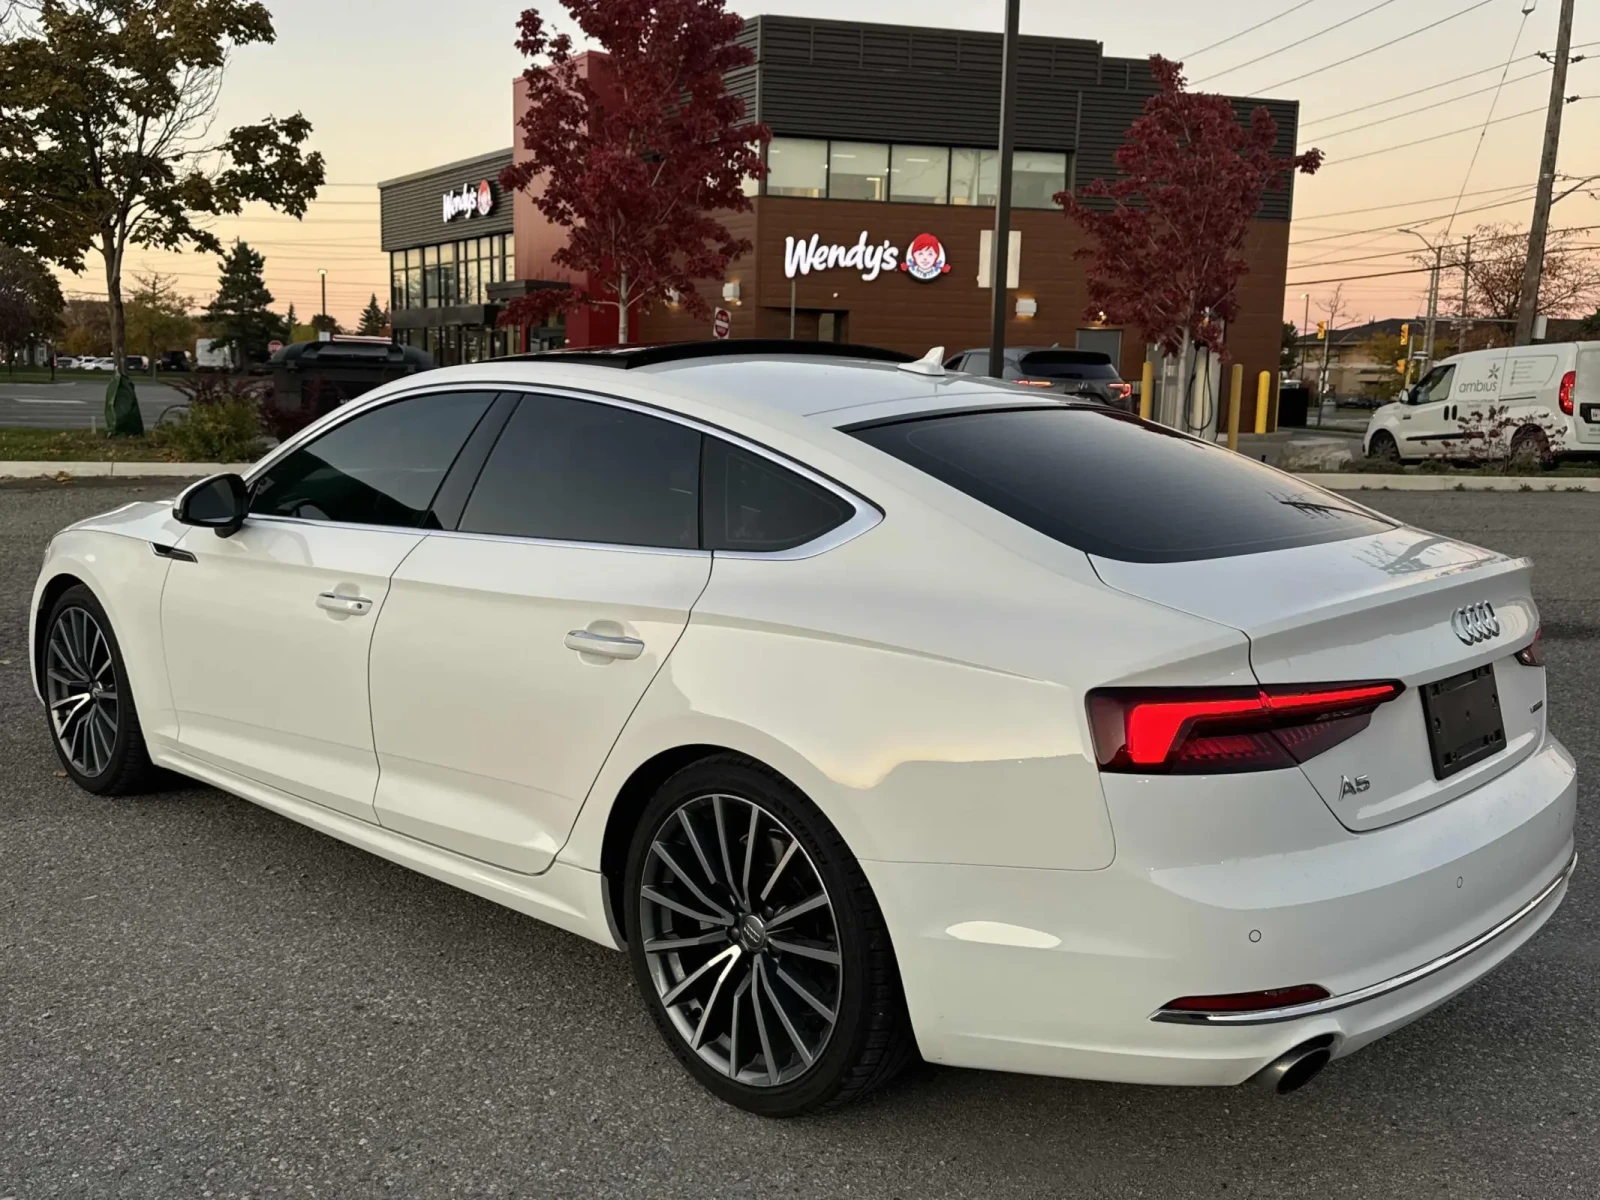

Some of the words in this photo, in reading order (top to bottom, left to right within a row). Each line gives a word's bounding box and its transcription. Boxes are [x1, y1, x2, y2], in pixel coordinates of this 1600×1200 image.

[443, 183, 477, 224] Wendy's
[785, 230, 899, 282] Wendy's
[1459, 379, 1498, 393] ambius
[1338, 774, 1371, 801] A5
